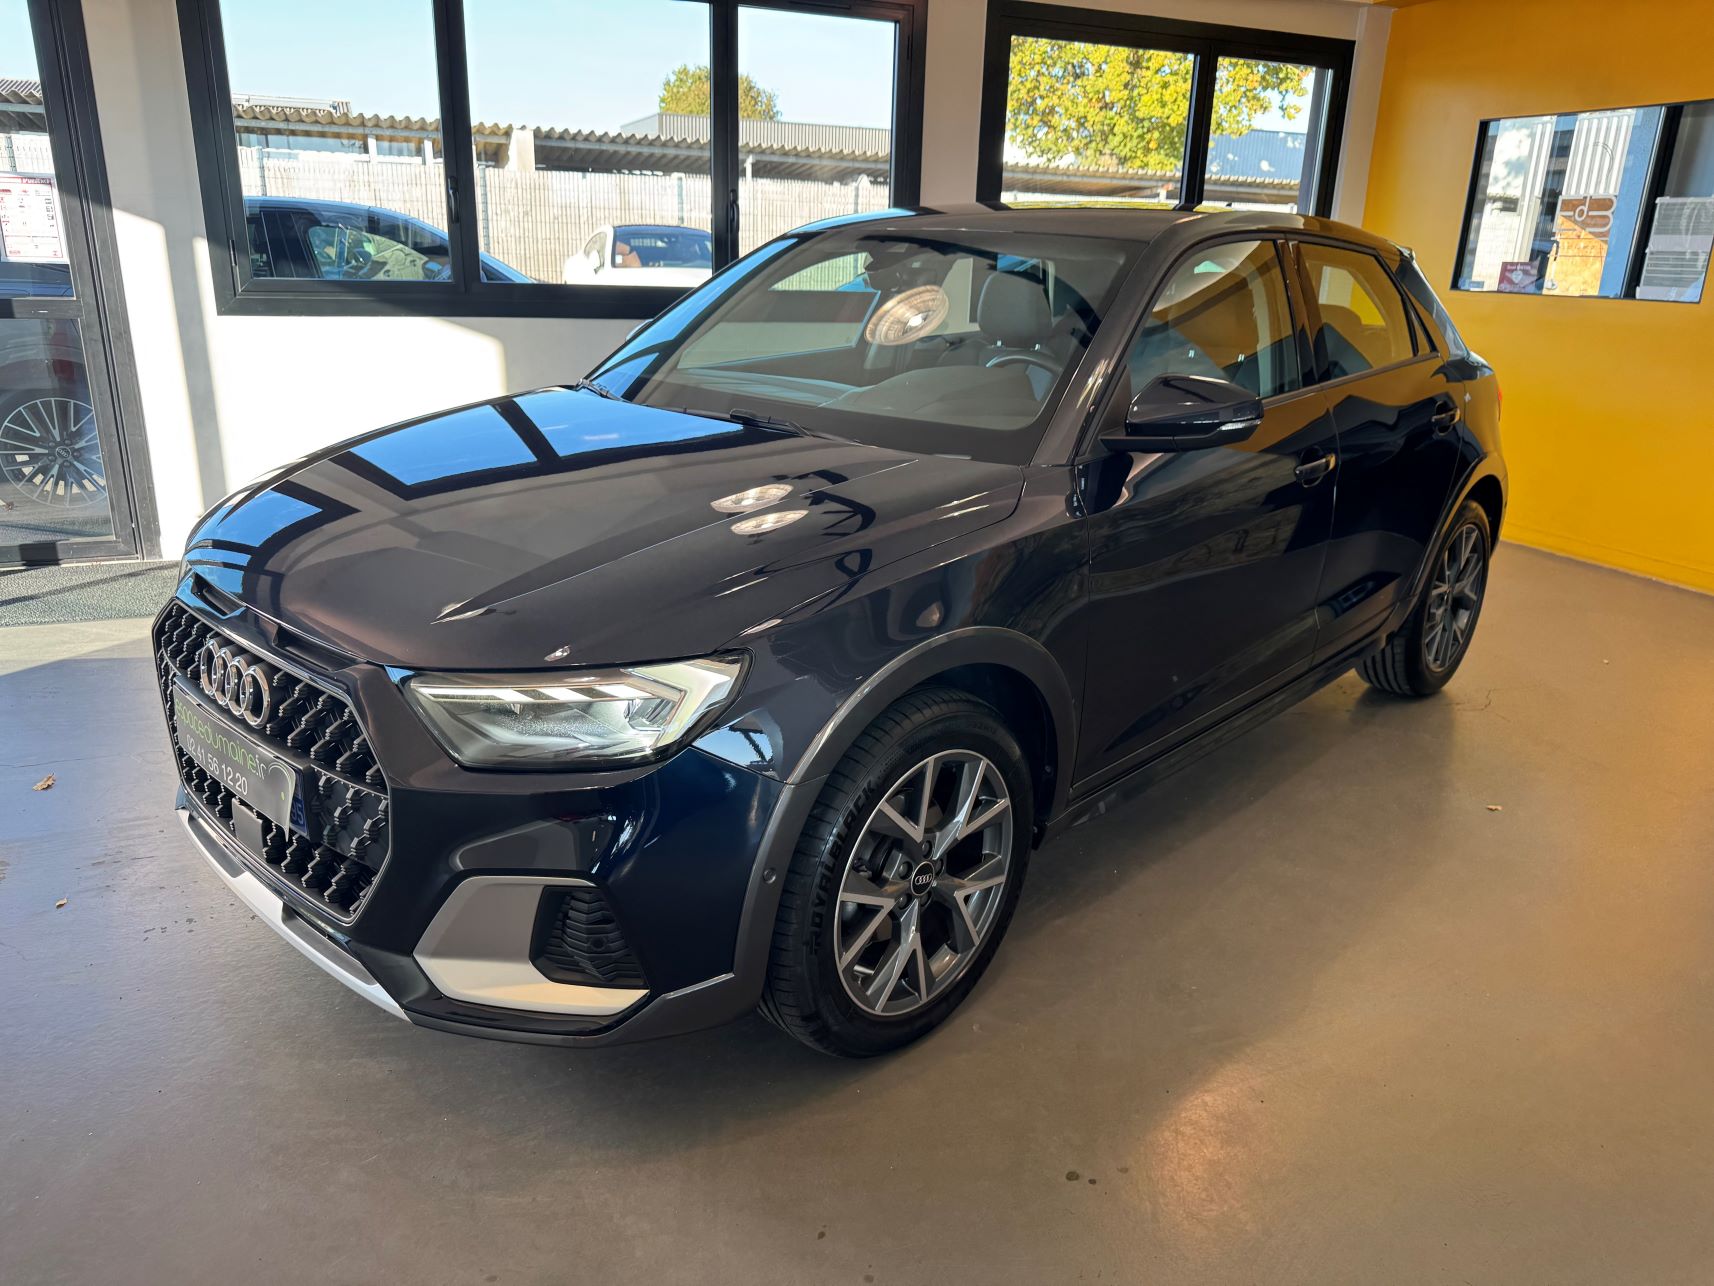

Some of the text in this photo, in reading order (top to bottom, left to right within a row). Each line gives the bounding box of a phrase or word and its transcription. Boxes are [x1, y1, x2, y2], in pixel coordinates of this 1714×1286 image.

[186, 734, 248, 796] 02 41 56 12 20
